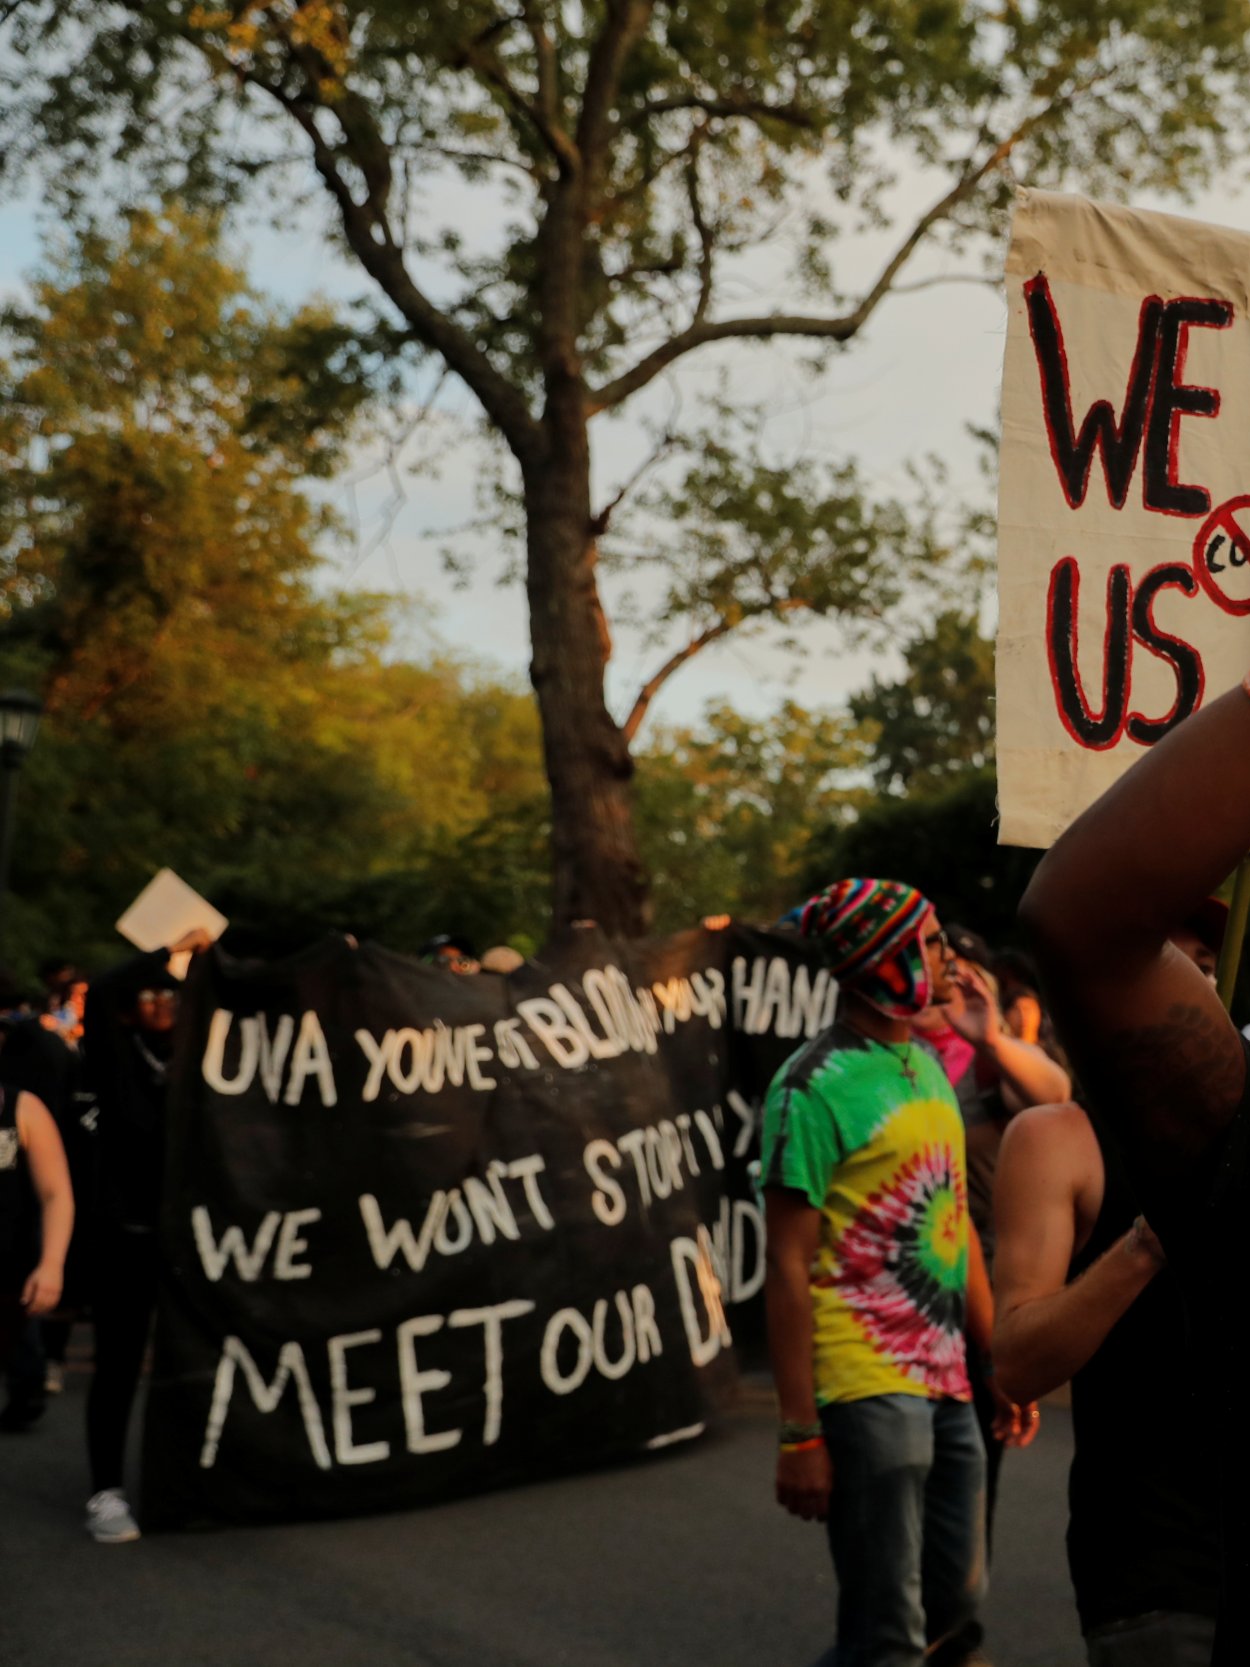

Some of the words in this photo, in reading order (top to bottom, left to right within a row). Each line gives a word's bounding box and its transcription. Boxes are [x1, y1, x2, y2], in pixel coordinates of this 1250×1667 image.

[1023, 271, 1233, 517] WE
[1047, 556, 1205, 750] US
[201, 1008, 338, 1107] UVA
[191, 1204, 322, 1281] WE
[358, 1153, 556, 1274] WON'T
[200, 1299, 536, 1472] MEET
[540, 1283, 663, 1396] OUR
